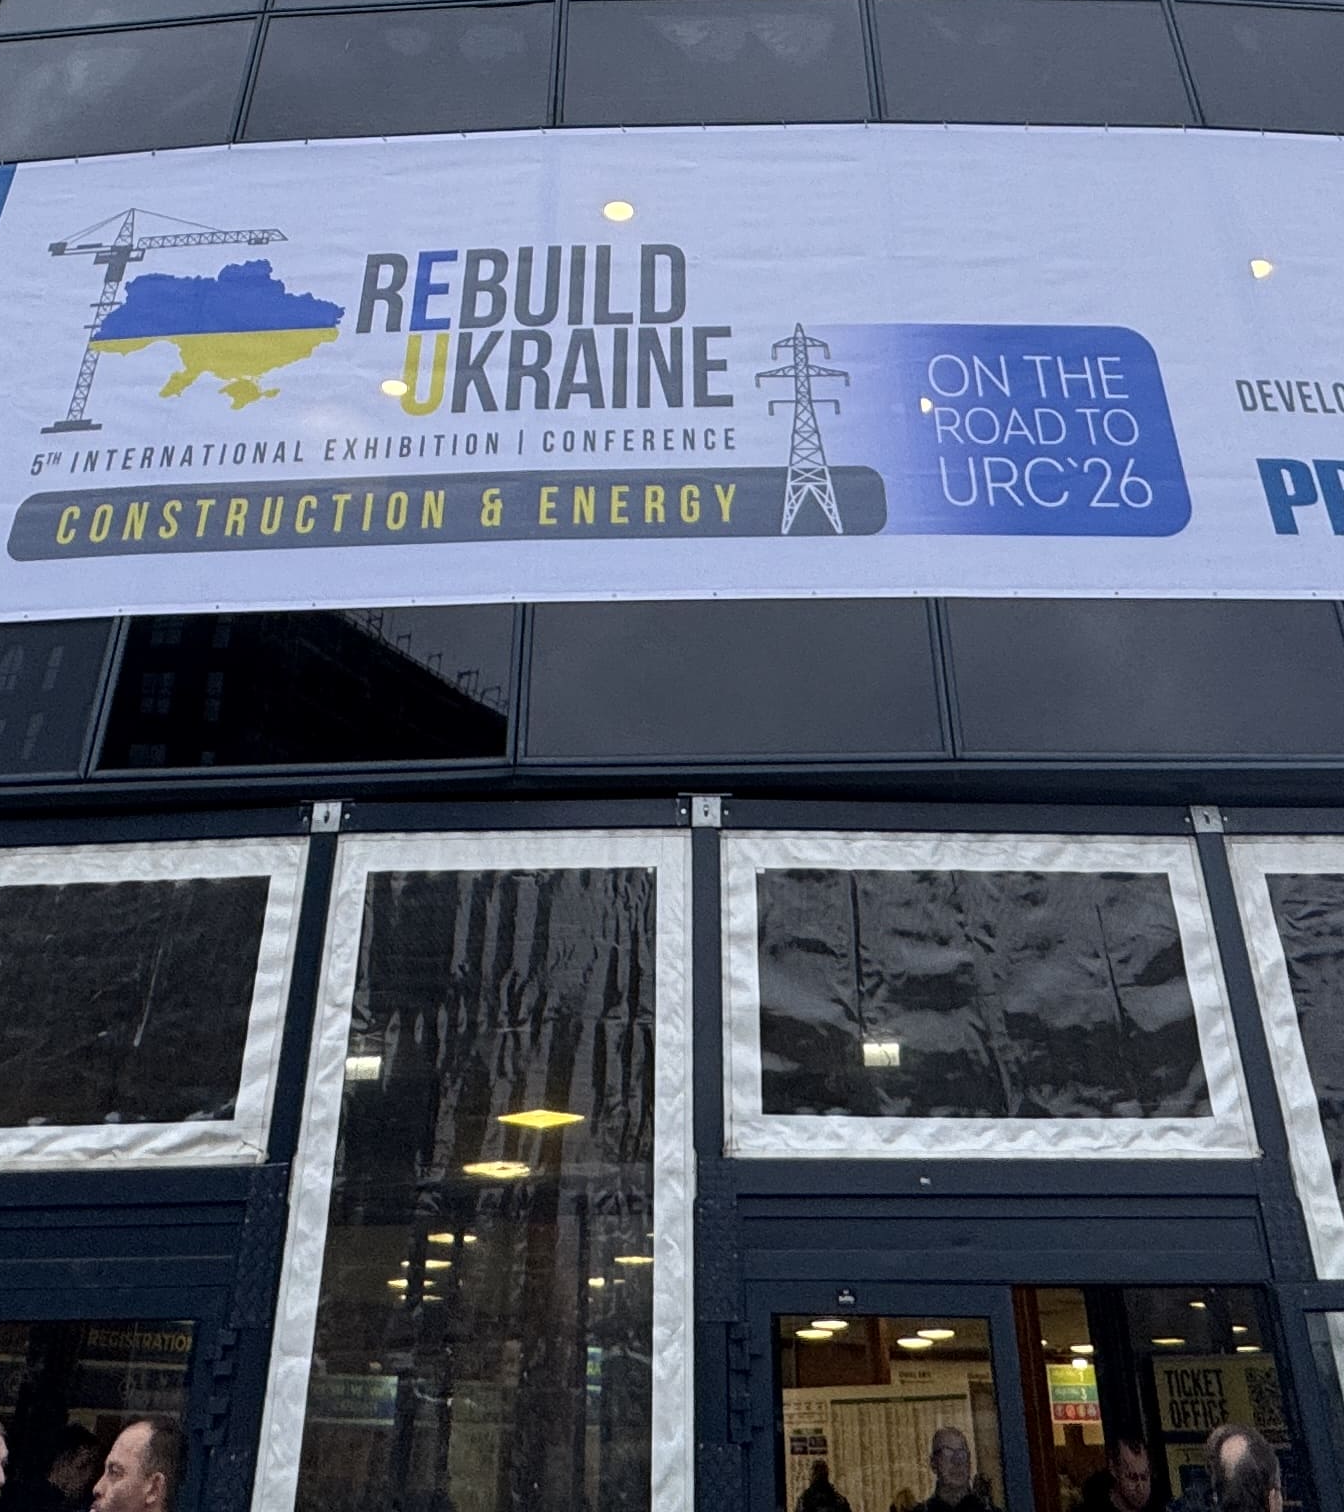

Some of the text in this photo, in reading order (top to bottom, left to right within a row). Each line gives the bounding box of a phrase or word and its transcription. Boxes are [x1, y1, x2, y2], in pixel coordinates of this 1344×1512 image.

[355, 243, 687, 335] REBUILD
[399, 326, 734, 417] UKRAINE
[928, 354, 1128, 400] ON THE
[70, 439, 305, 474] INTERNATIONAL
[323, 431, 502, 462] EXHIBITION
[542, 426, 738, 455] CONFERENCE
[934, 406, 1140, 447] ROAD TO
[56, 484, 739, 545] CONSTRUCTION & ENERGY
[1164, 1369, 1224, 1398] TICKET
